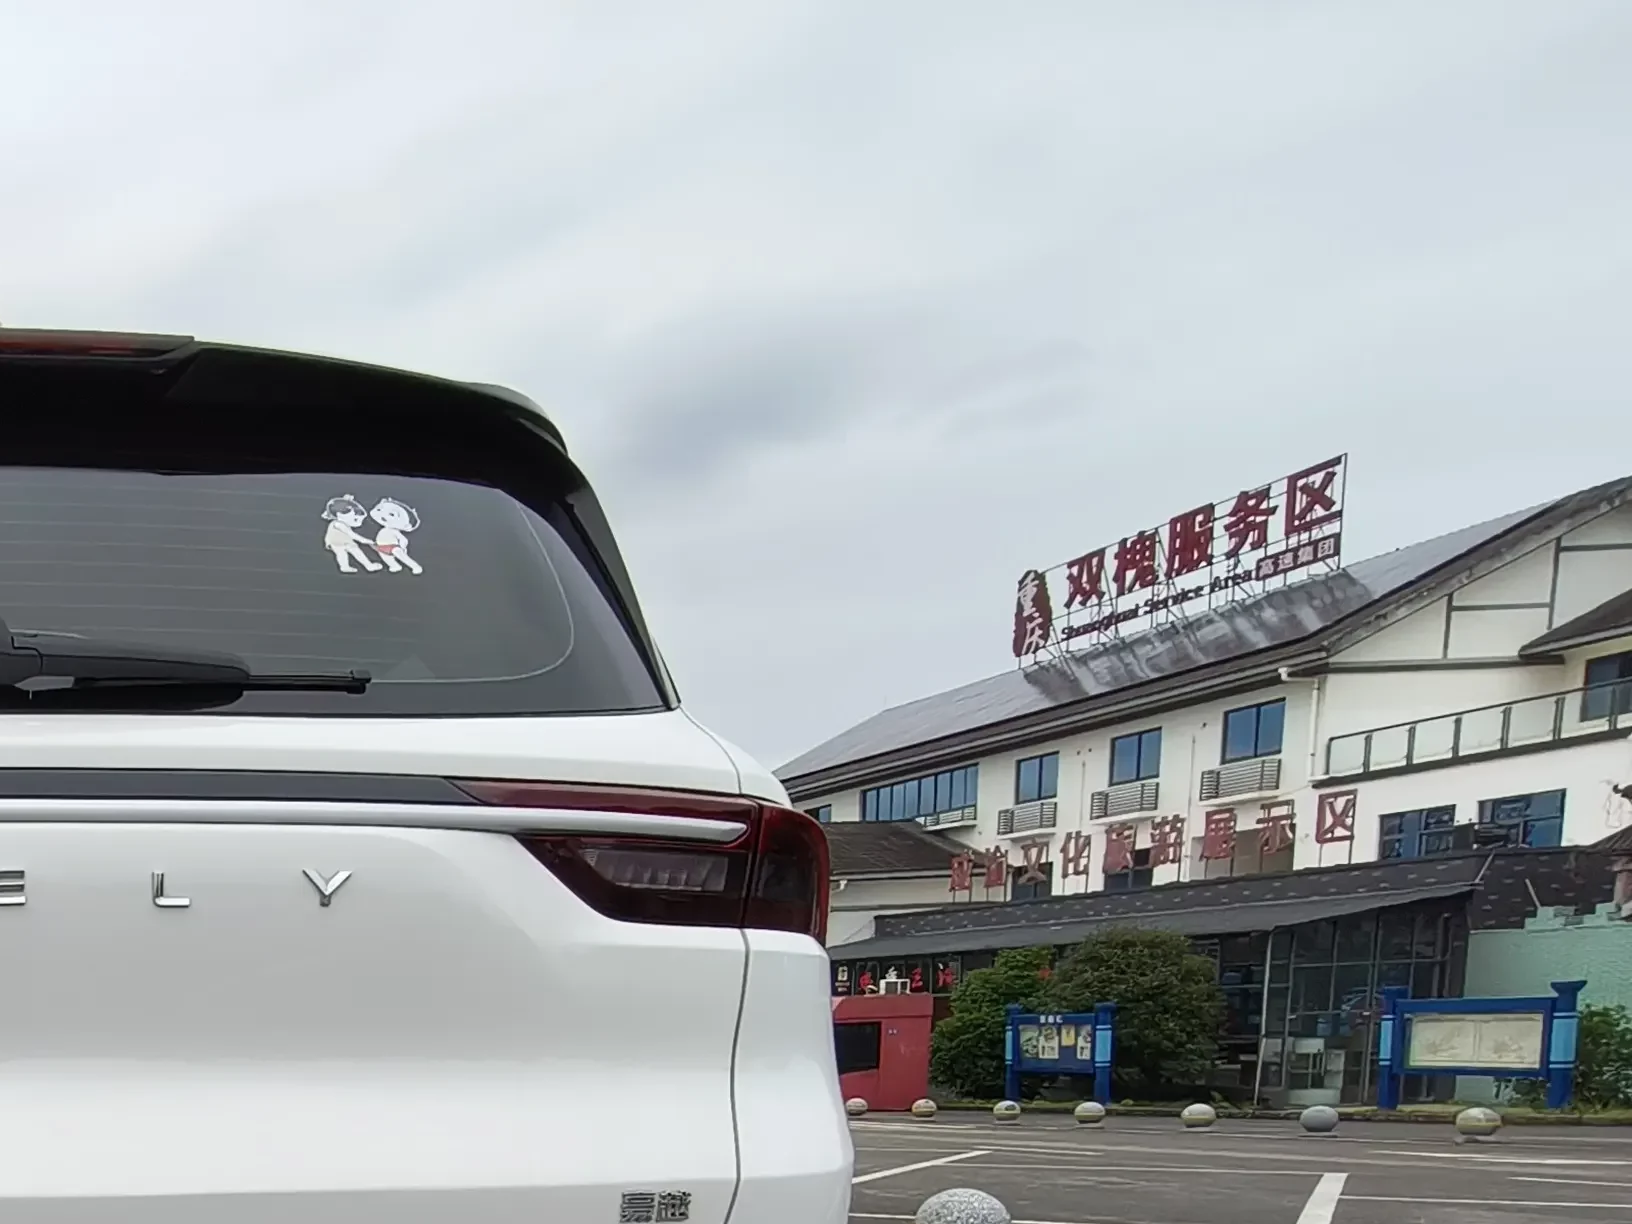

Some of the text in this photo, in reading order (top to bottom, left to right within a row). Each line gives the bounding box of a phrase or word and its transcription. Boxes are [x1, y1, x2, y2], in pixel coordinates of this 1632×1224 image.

[1064, 455, 1342, 608] 双槐服务区
[1017, 571, 1045, 655] 重庆
[1210, 569, 1253, 594] Area
